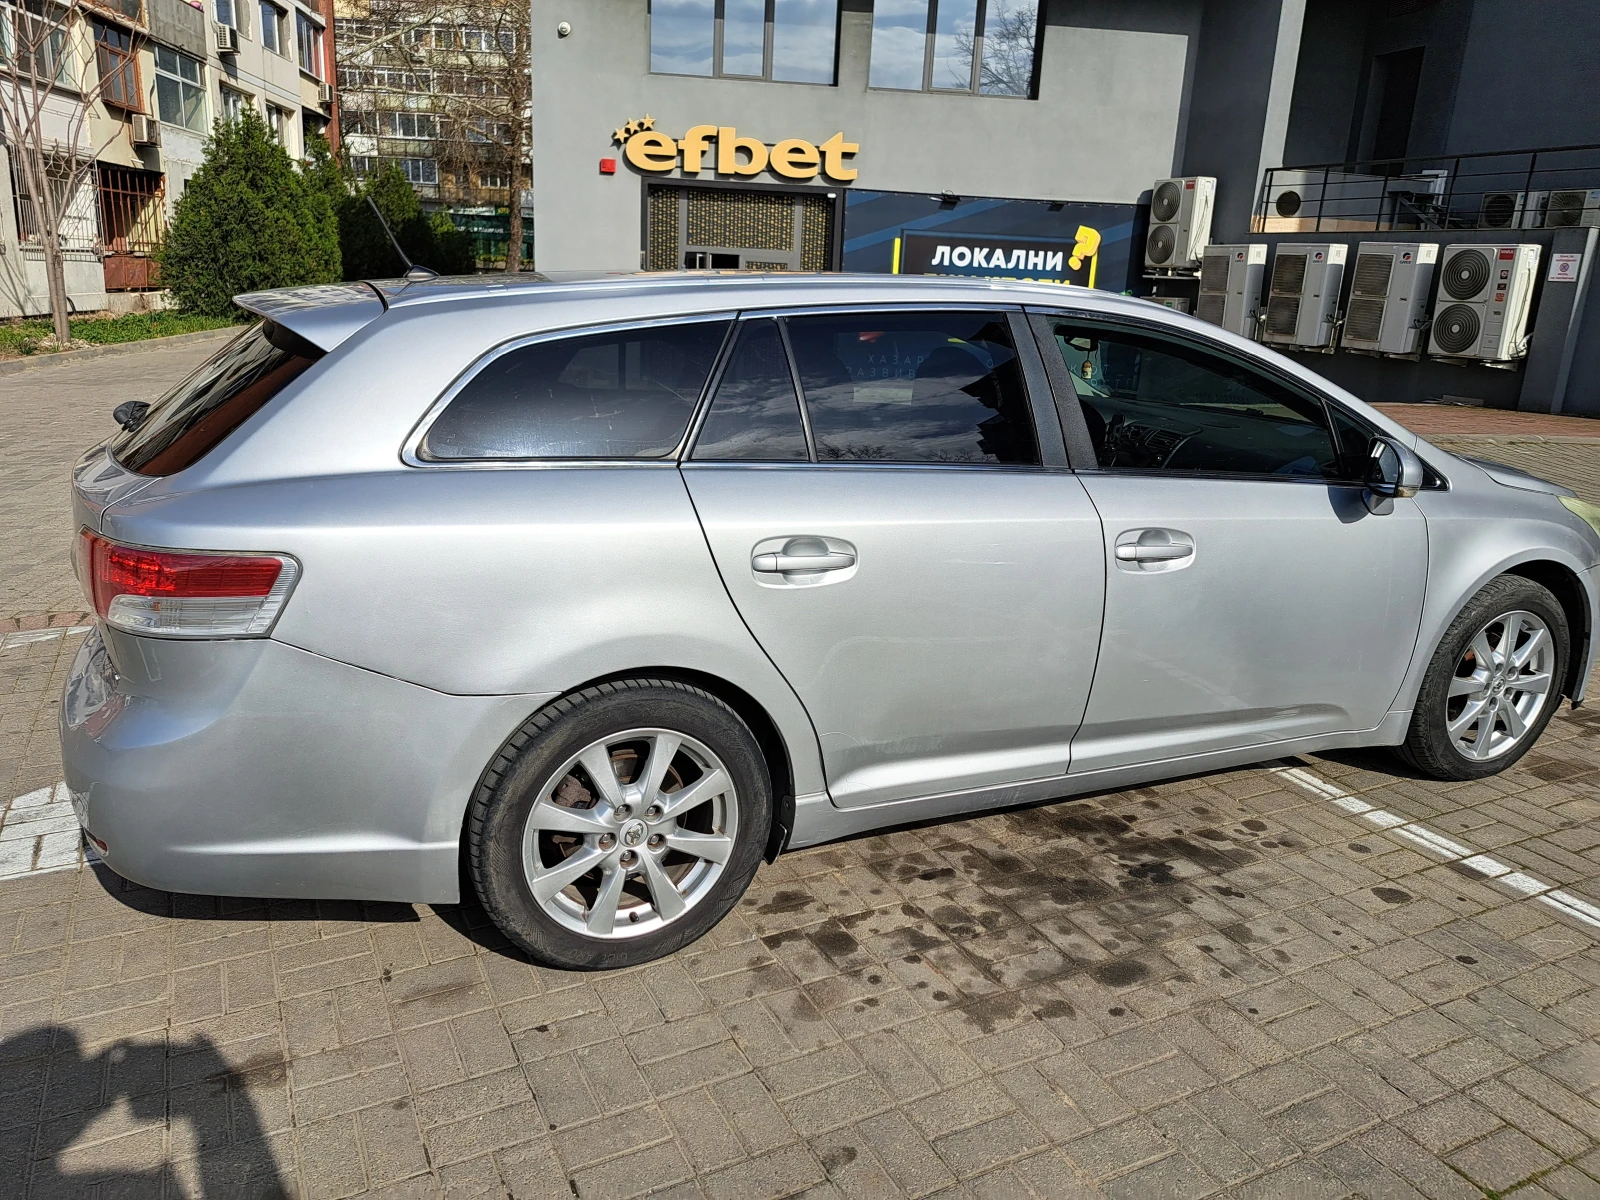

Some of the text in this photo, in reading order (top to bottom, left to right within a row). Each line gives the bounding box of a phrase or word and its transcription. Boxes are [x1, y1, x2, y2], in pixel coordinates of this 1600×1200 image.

[625, 124, 860, 181] efbet
[931, 245, 1064, 272] ЛОКАЛНИ
[867, 354, 924, 365] ХАЗАР
